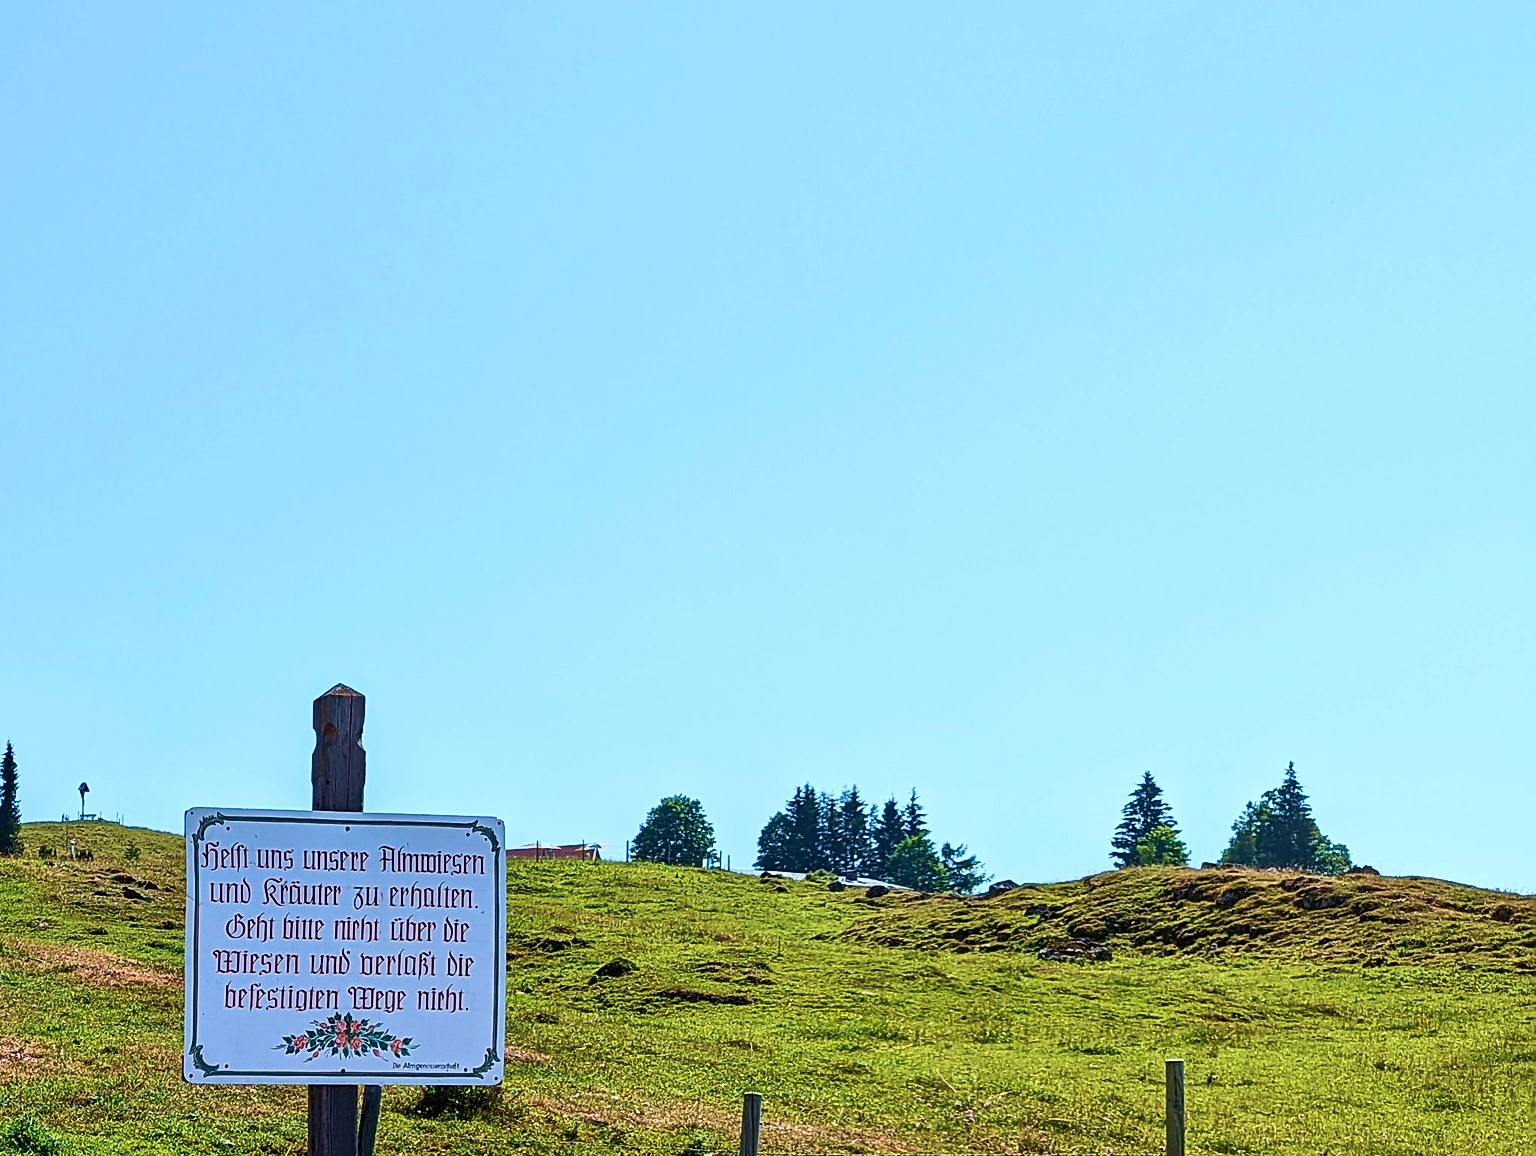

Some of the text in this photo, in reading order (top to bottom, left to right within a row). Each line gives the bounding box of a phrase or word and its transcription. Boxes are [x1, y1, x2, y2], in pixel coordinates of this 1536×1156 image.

[201, 841, 485, 876] Helft uns unsere Almwiesen
[210, 877, 479, 910] und Kräuter zu erhalten.
[226, 912, 470, 943] Geht bitte nicht über die
[213, 948, 475, 980] Wiesen und verlaßt die
[224, 981, 470, 1014] befestigten Wege nicht.
